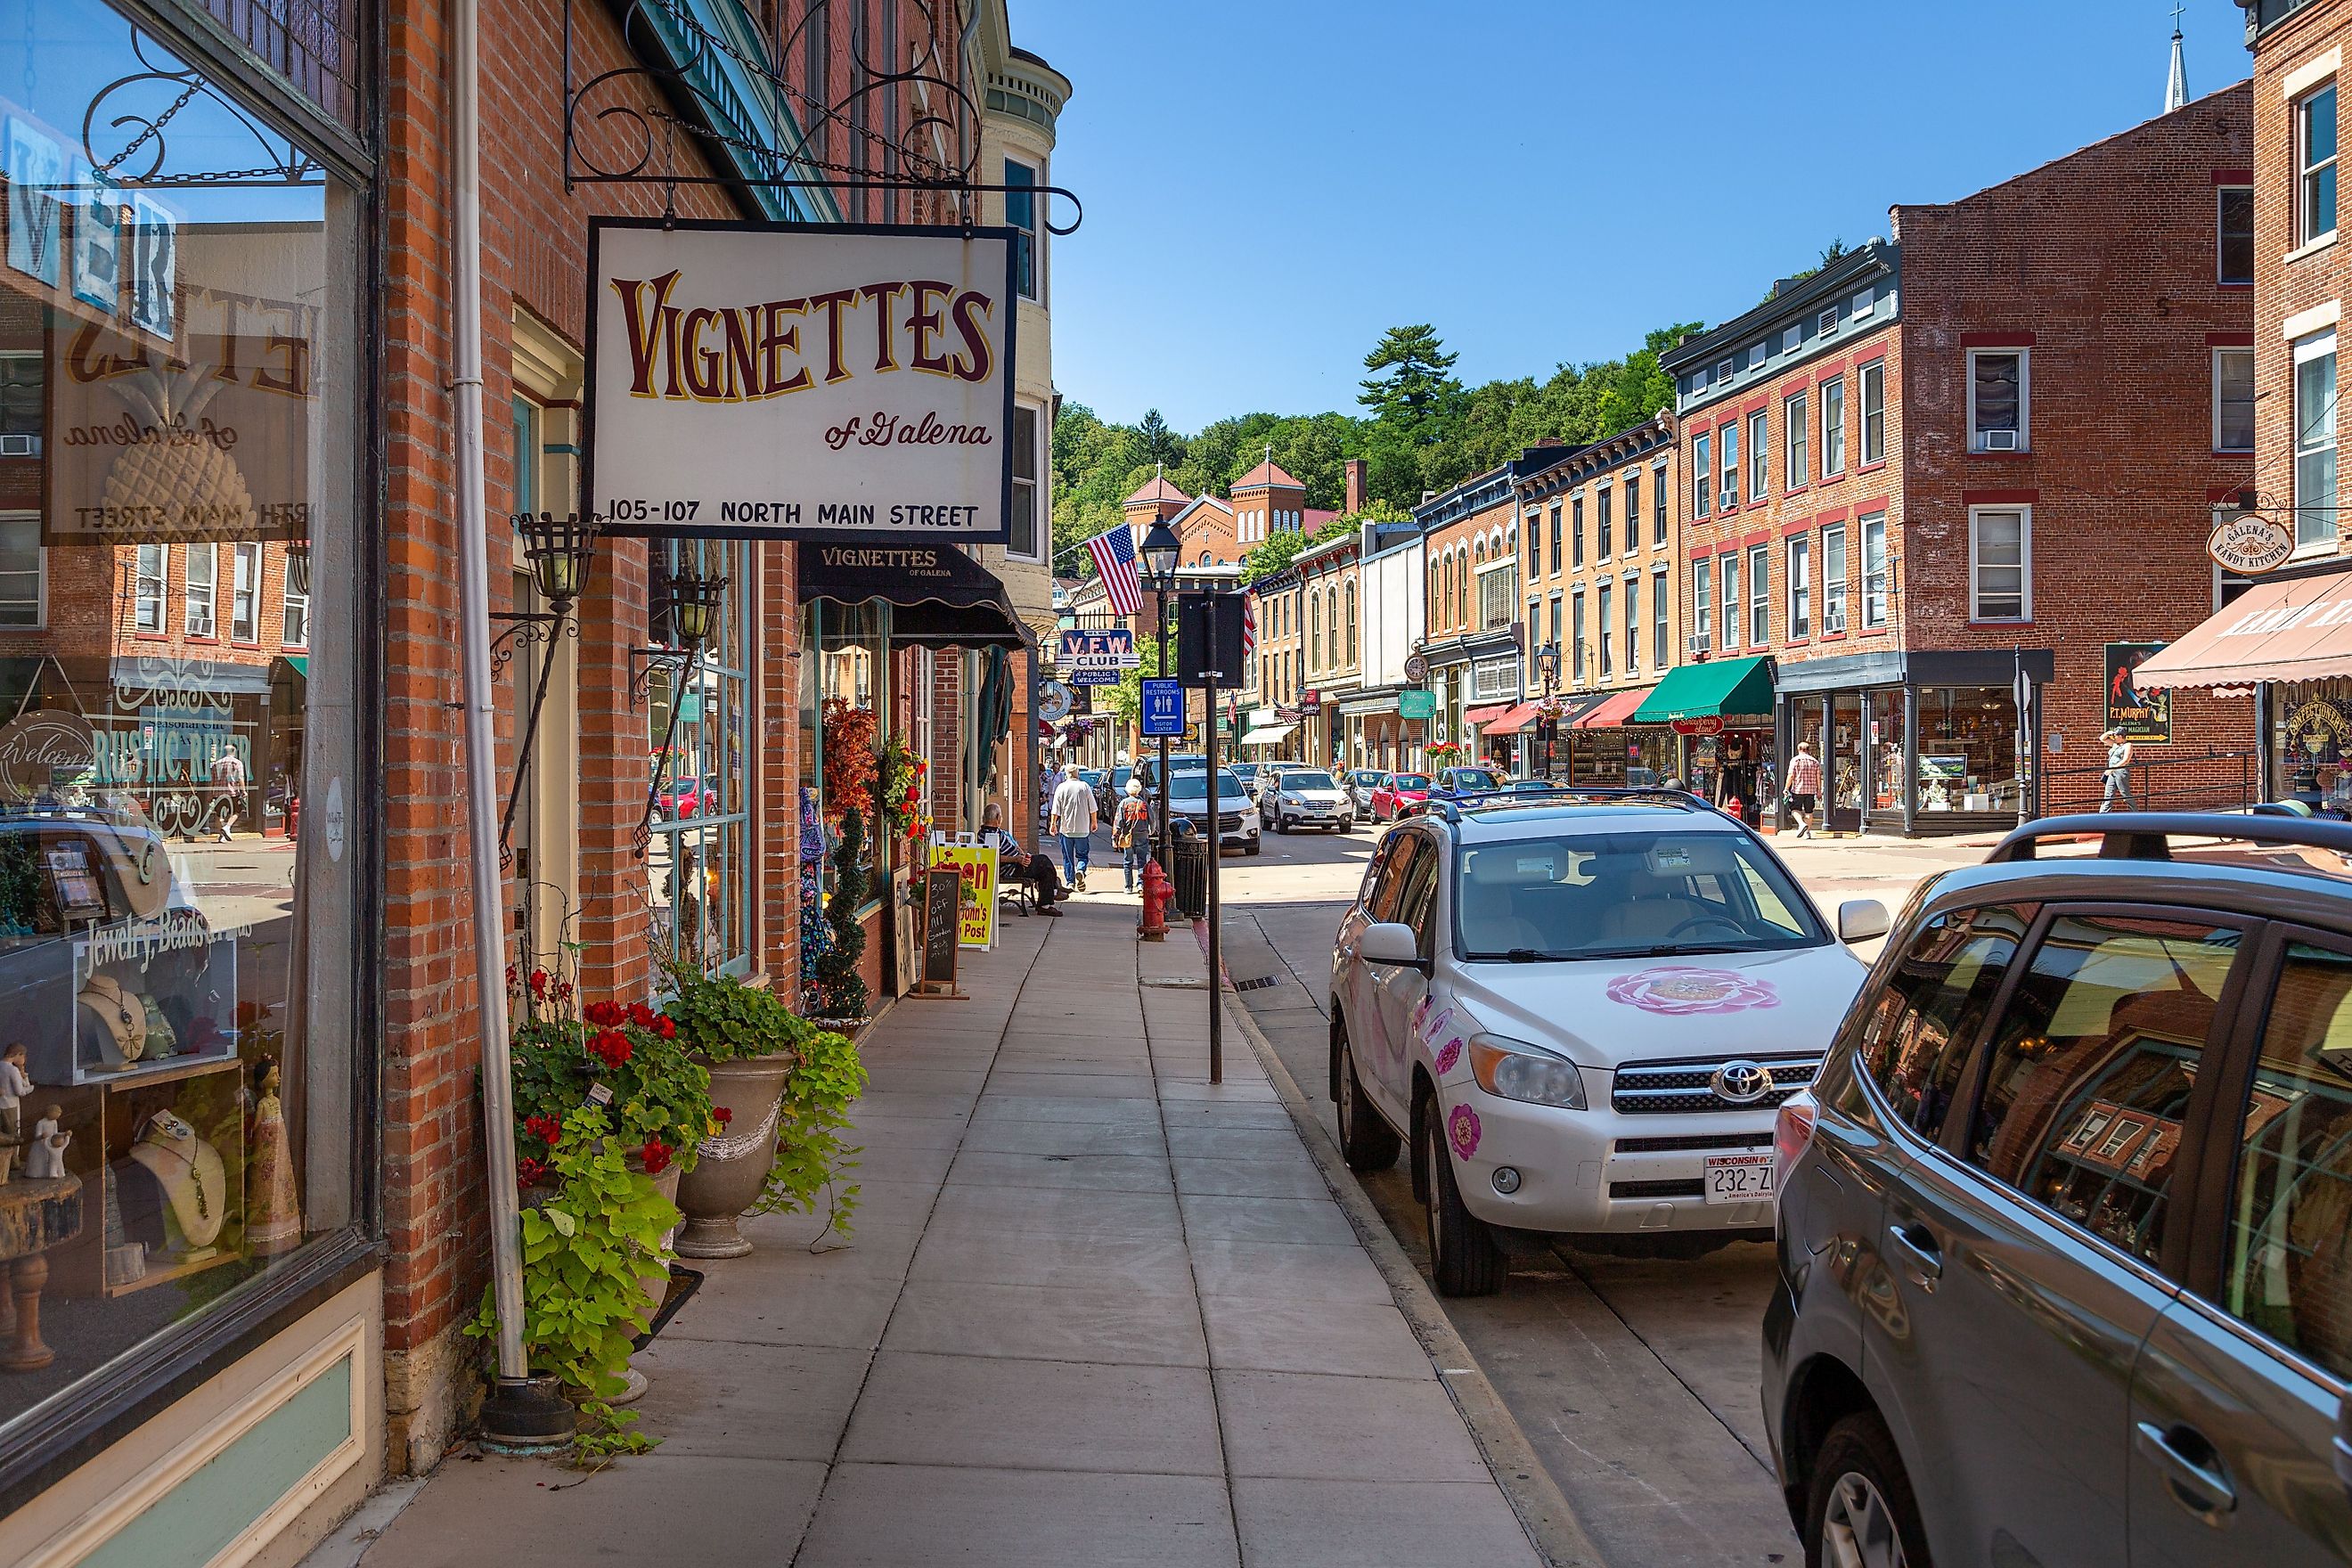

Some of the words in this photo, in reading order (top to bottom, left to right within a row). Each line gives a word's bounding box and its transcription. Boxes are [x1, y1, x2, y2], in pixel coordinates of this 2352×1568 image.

[610, 268, 994, 404] VIGNETTES
[824, 416, 861, 450] of
[859, 411, 992, 446] Galena
[609, 499, 700, 521] 105-107
[721, 501, 801, 524] NORTH
[817, 502, 875, 525] MAIN
[890, 504, 979, 527] STREET
[2227, 525, 2274, 542] GALENA'S
[821, 546, 937, 568] VIGNETTES
[2214, 543, 2245, 567] KANDY
[2249, 543, 2288, 568] KITCHEN
[920, 569, 951, 577] GALENA
[1076, 657, 1119, 666] CLUB
[2120, 706, 2151, 721] MURPHY
[2290, 703, 2345, 736] CONFECTIONERY
[1695, 725, 1712, 733] Lane
[0, 731, 95, 765] Welcom
[91, 729, 183, 783] RUSTIC
[189, 732, 255, 783] RIVER
[931, 878, 952, 898] 30%
[964, 923, 986, 939] Post
[85, 911, 156, 979] Jewelry,
[158, 908, 204, 953] Beads
[1708, 1156, 1759, 1166] WISCONSIN
[1714, 1166, 1774, 1193] 232-Z
